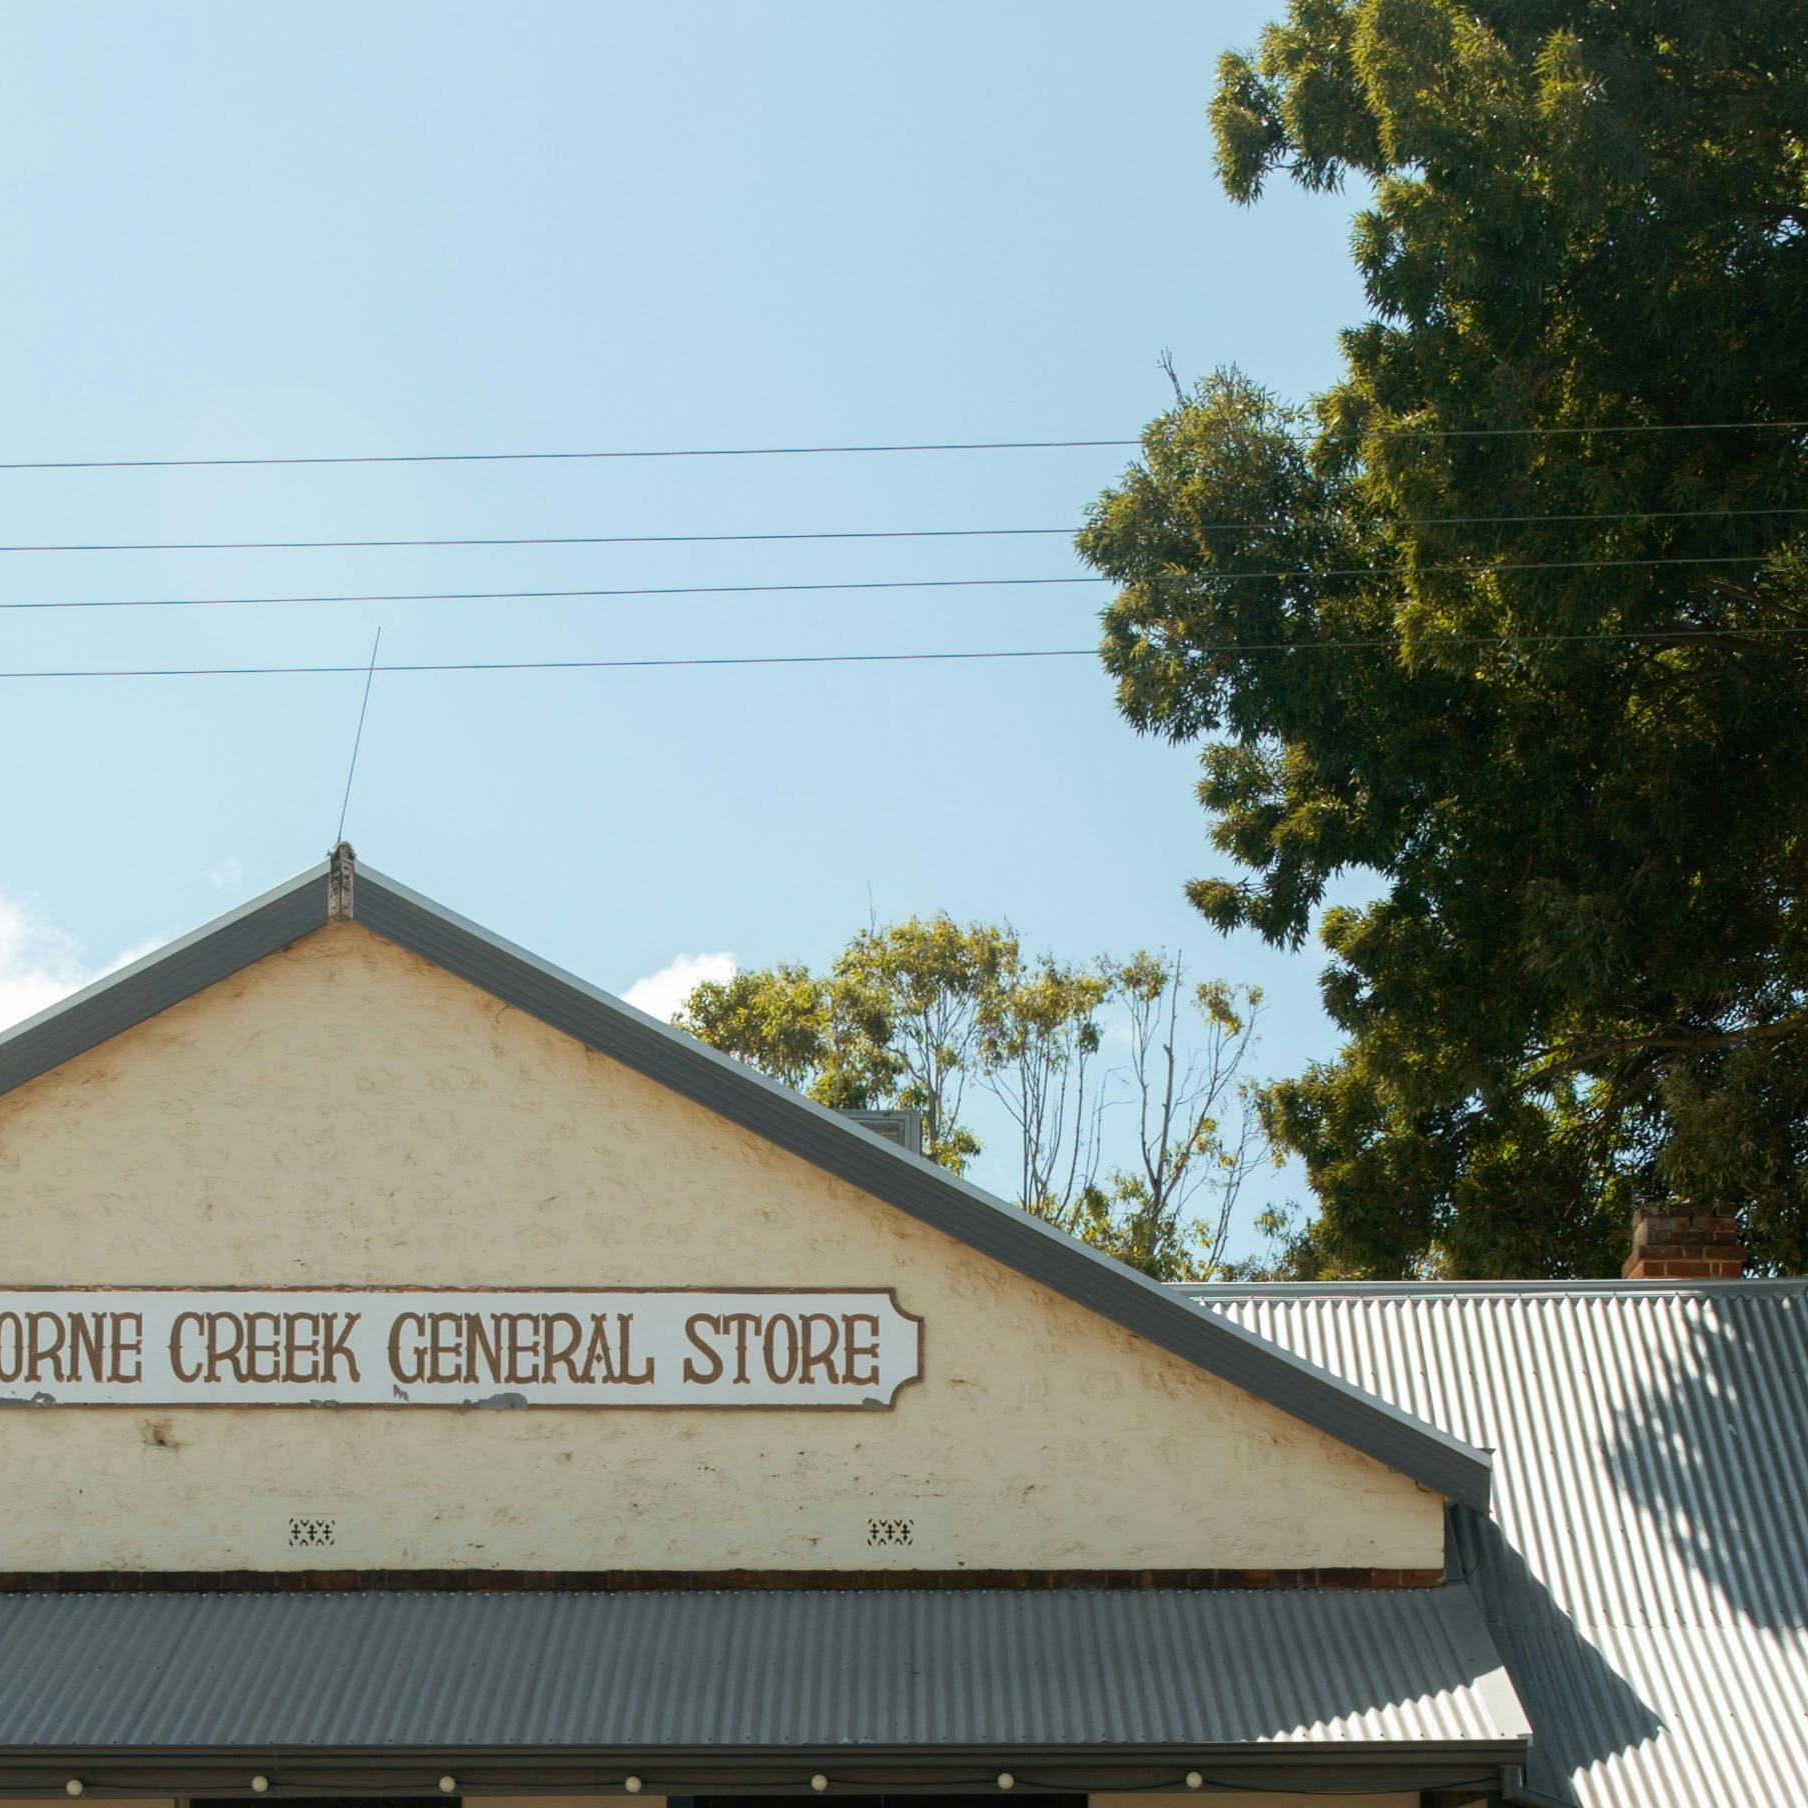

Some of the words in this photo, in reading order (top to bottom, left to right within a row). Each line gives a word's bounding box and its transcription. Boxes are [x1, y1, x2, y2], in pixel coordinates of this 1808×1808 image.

[167, 1312, 361, 1386] CREEK
[387, 1313, 655, 1387] GENERAL
[682, 1313, 880, 1388] STORE
